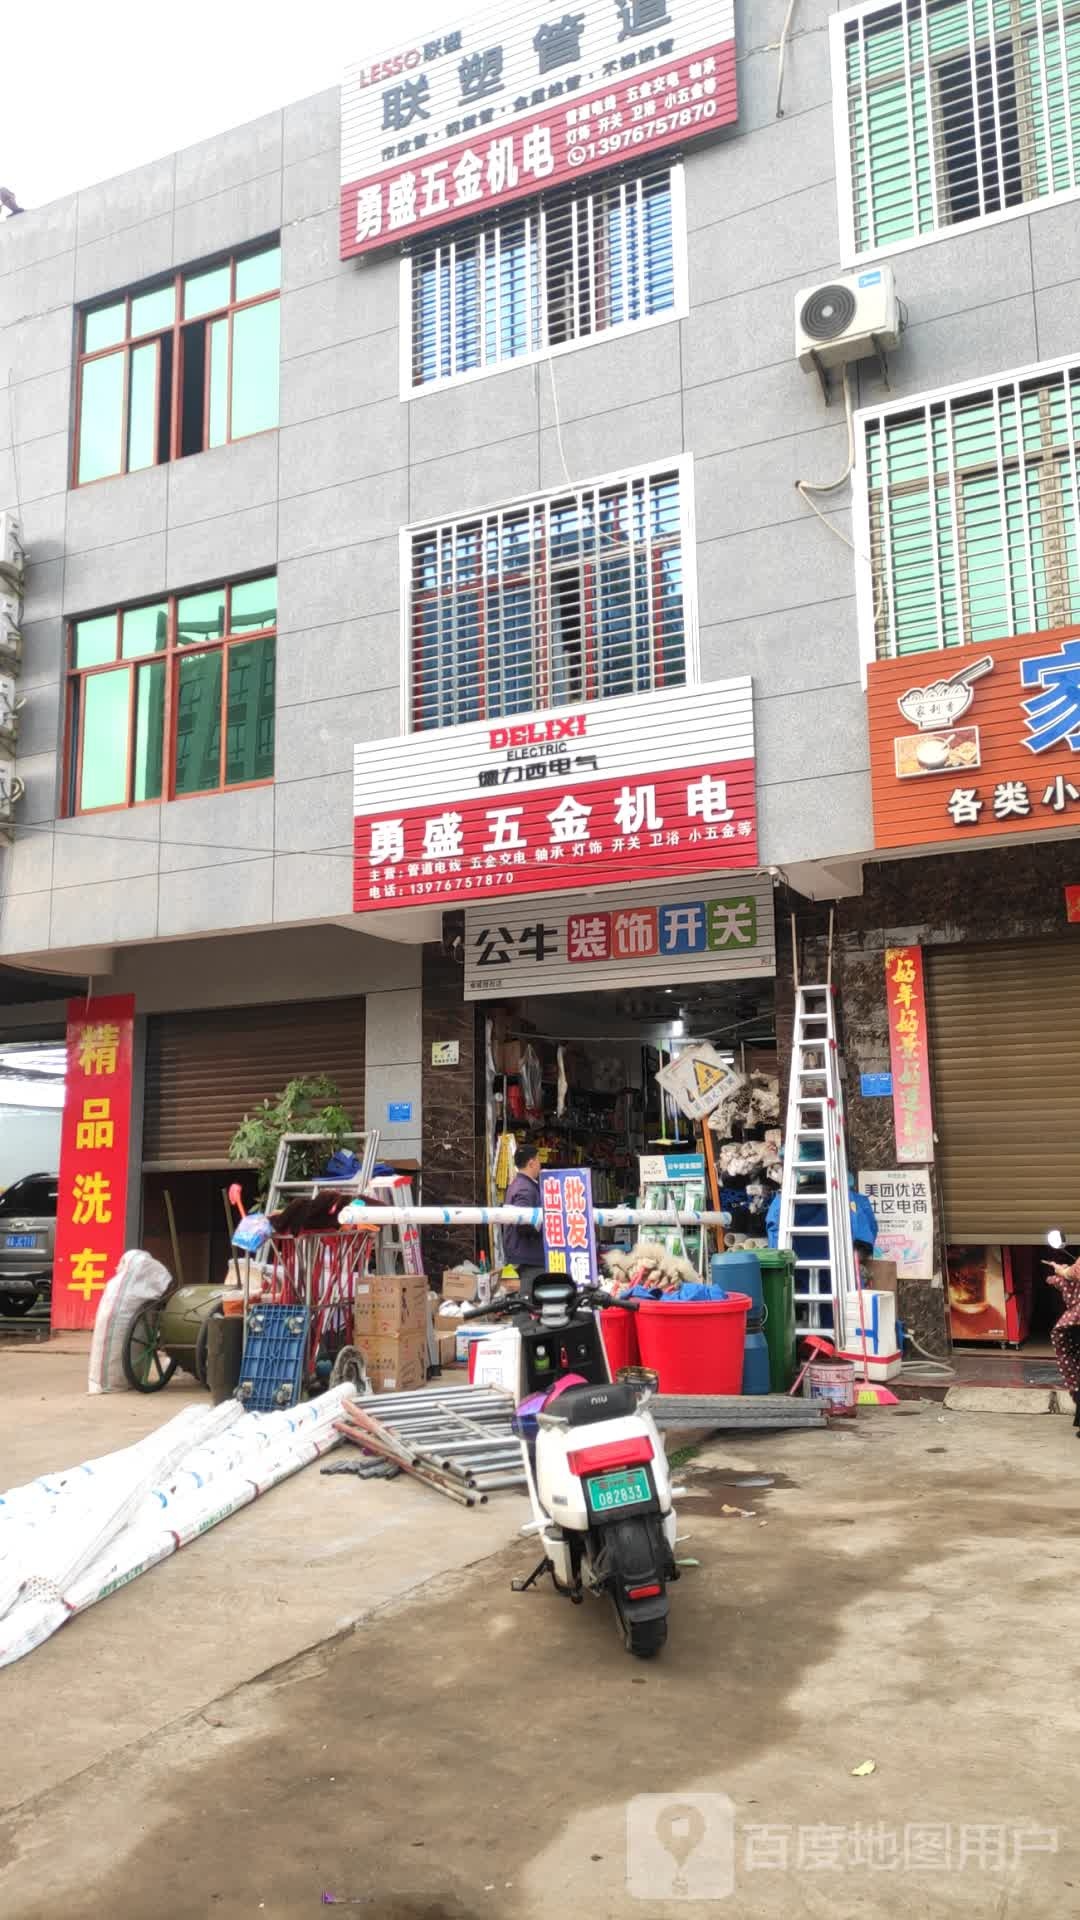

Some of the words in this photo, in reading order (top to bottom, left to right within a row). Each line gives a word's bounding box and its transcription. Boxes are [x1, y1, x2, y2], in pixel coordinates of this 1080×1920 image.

[360, 48, 421, 88] LESSO
[381, 0, 673, 131] 联塑管道
[599, 112, 623, 134] 开关
[664, 77, 717, 109] 小五金等
[587, 101, 716, 159] 13976757870
[355, 125, 554, 243] 勇盛五金机电
[488, 714, 587, 750] DELIXI
[506, 742, 567, 761] ELECTRIC
[478, 755, 598, 788] 德力西电气
[368, 775, 734, 866] 勇盛五金机电
[948, 776, 1080, 824] 各类小
[471, 851, 527, 869] 五金交电
[535, 844, 564, 862] 轴承
[573, 841, 603, 857] 灯饰
[612, 837, 641, 853] 开关
[649, 831, 680, 847] 卫浴
[688, 821, 752, 842] 小五金等
[476, 902, 753, 966] 公牛装饰开关
[66, 1024, 120, 1301] 精品洗车
[864, 1183, 928, 1198] 美团优选
[598, 1485, 643, 1506] 082833
